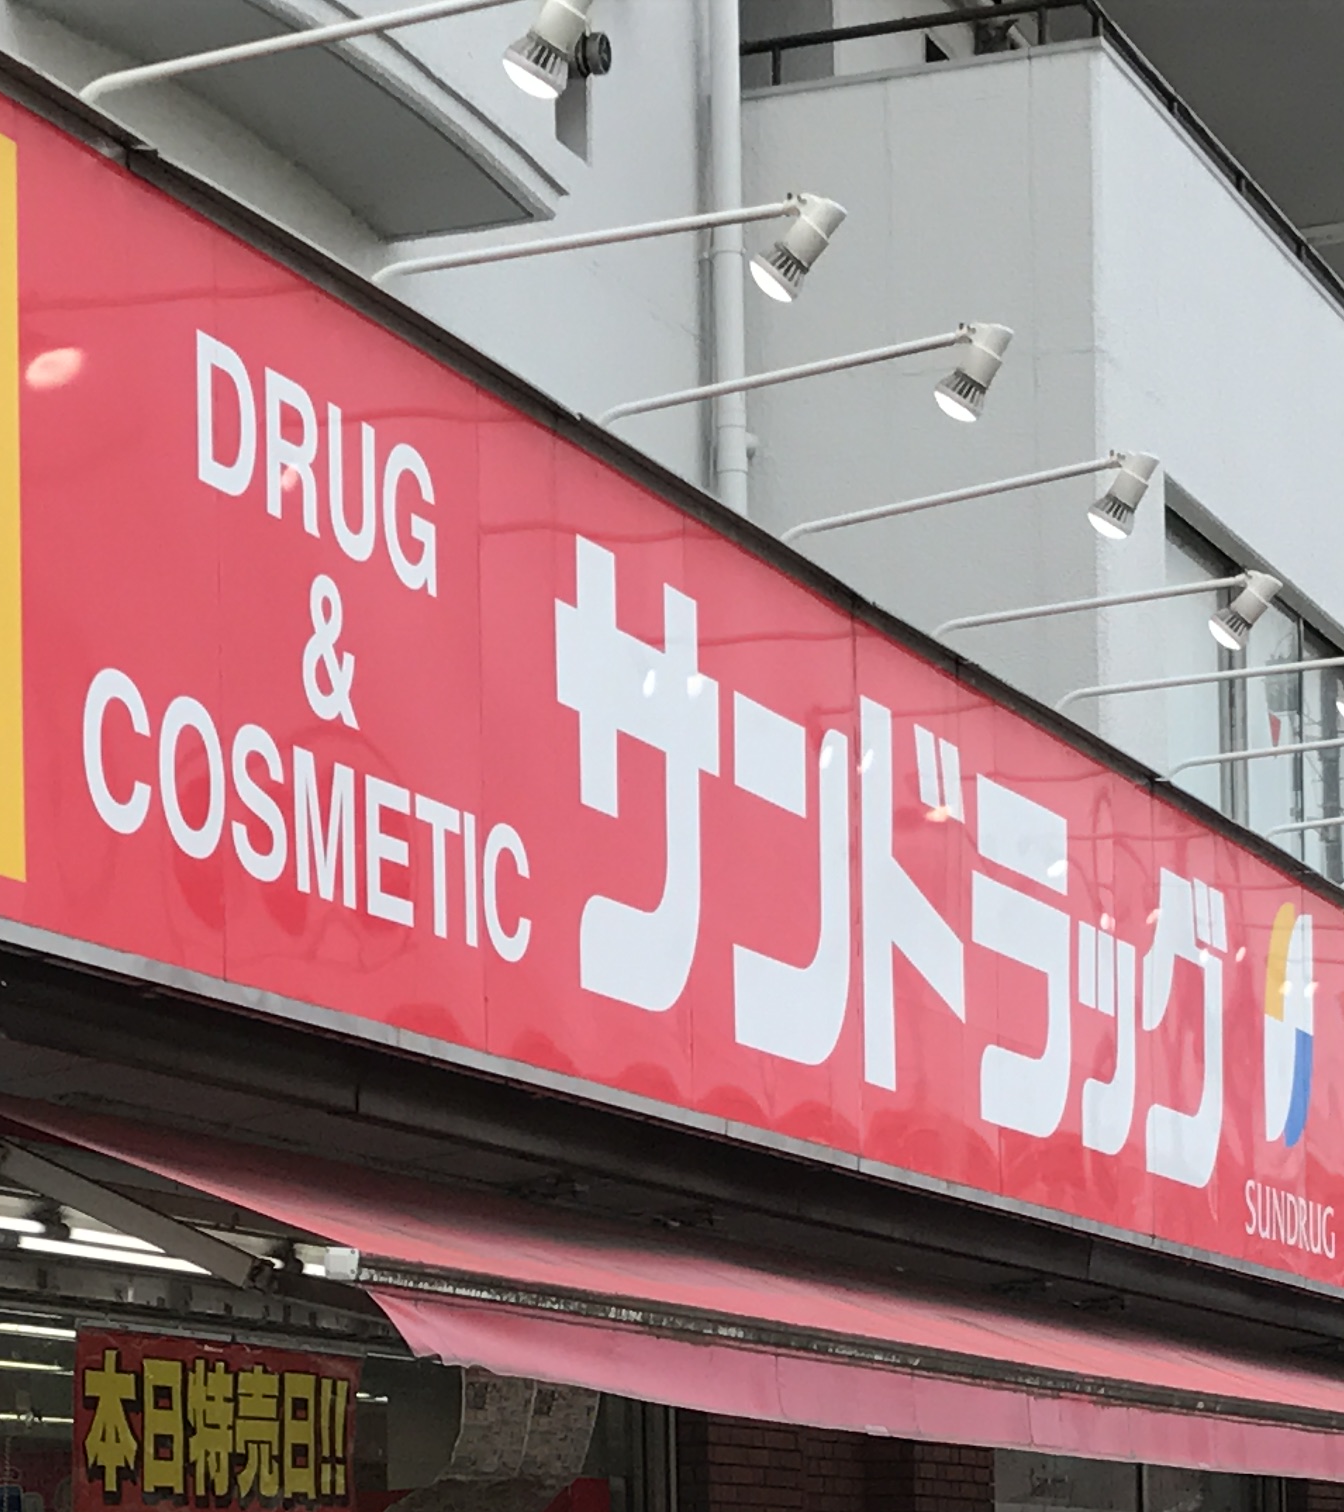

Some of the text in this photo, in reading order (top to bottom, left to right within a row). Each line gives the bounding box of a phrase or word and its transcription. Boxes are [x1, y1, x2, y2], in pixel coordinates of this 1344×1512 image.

[195, 328, 437, 597] DRUG
[302, 574, 360, 729] &
[83, 668, 531, 962] COSMETIC
[555, 533, 1225, 1189] サンドラッグ
[1245, 1179, 1335, 1259] SUNDRUG
[83, 1347, 349, 1500] 本日特売日!!
